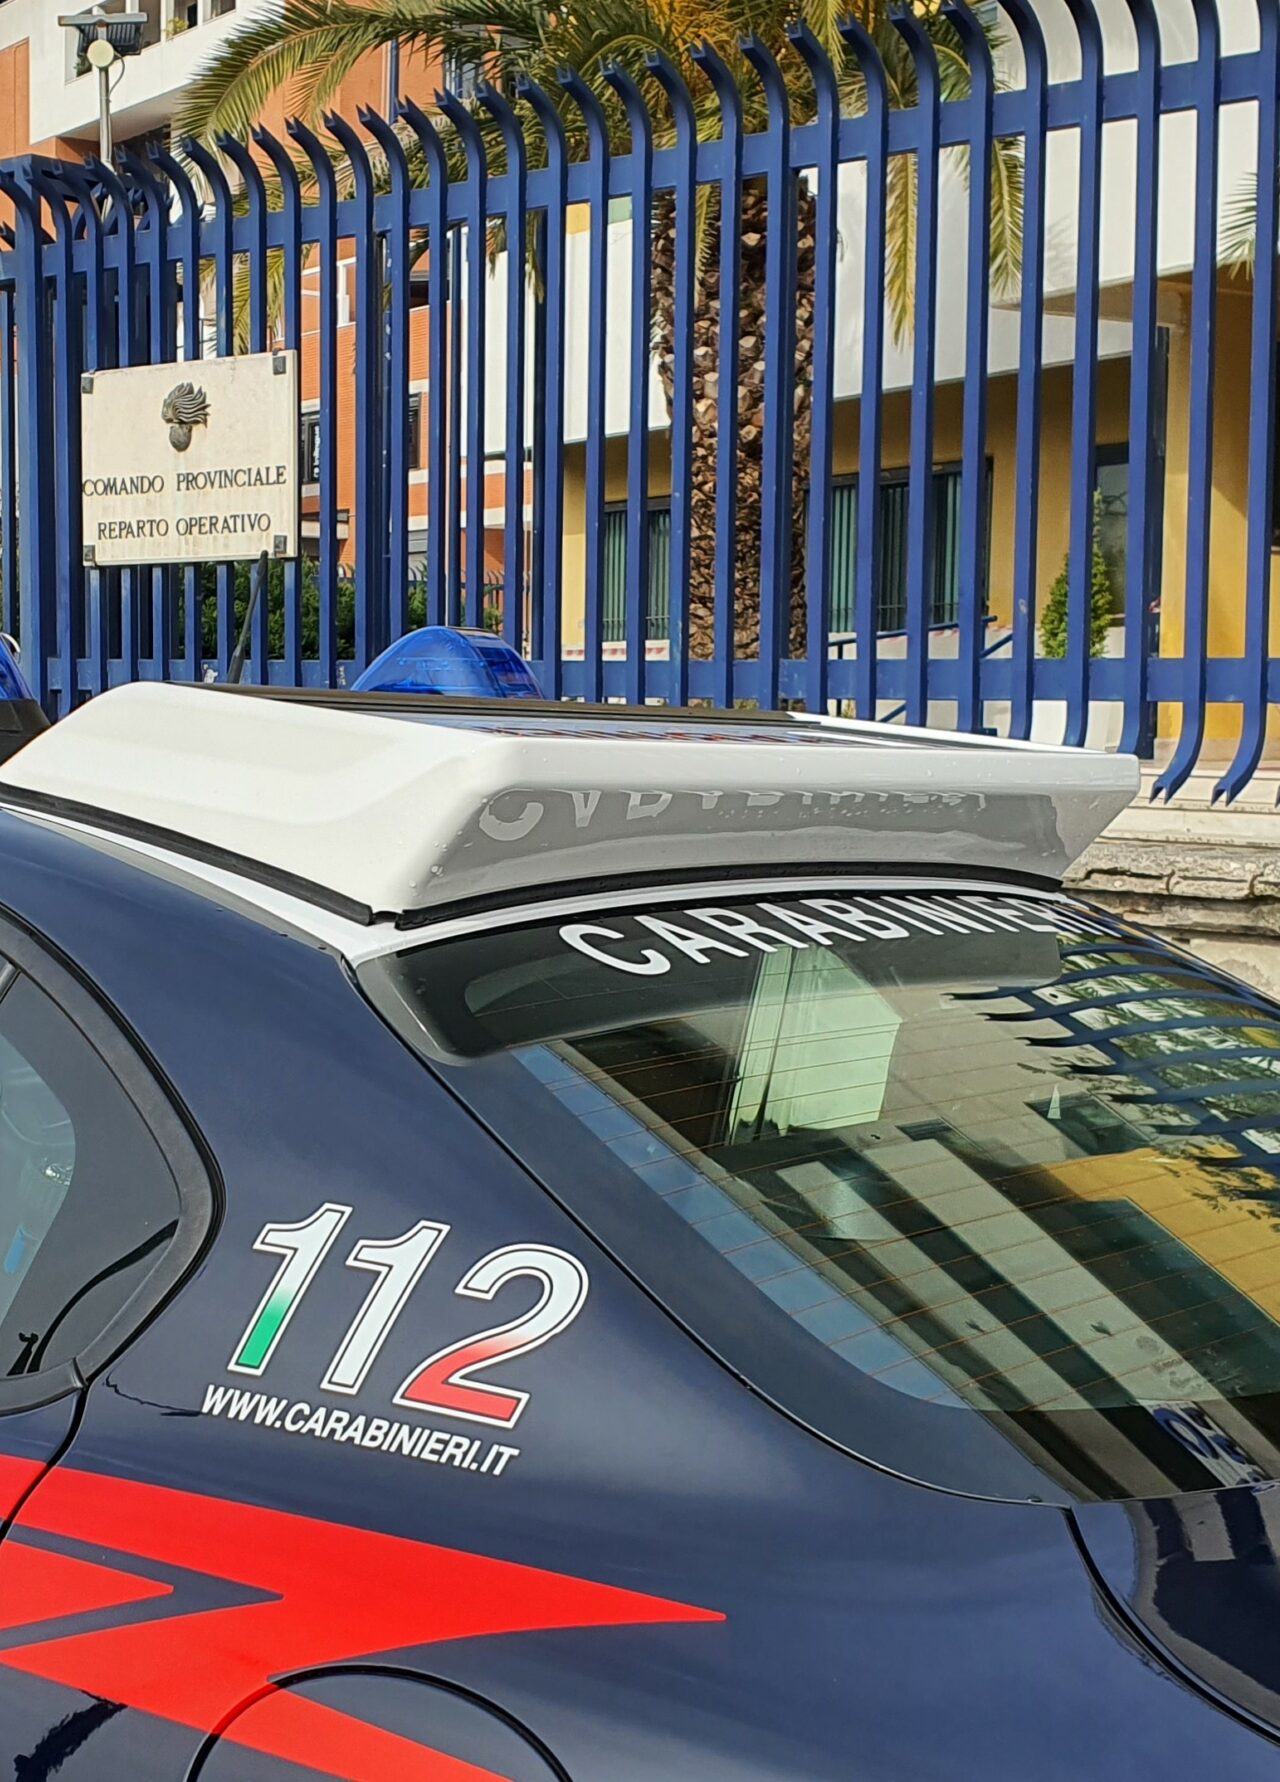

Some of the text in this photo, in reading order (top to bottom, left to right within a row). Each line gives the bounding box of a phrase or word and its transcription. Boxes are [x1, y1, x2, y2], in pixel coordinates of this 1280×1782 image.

[82, 465, 287, 497] COMANDO PROVINCIALE
[97, 513, 272, 540] REPARTO OPERATIVO
[227, 1202, 590, 1430] 112
[200, 1383, 520, 1477] WWW.CARABINIERI.IT
